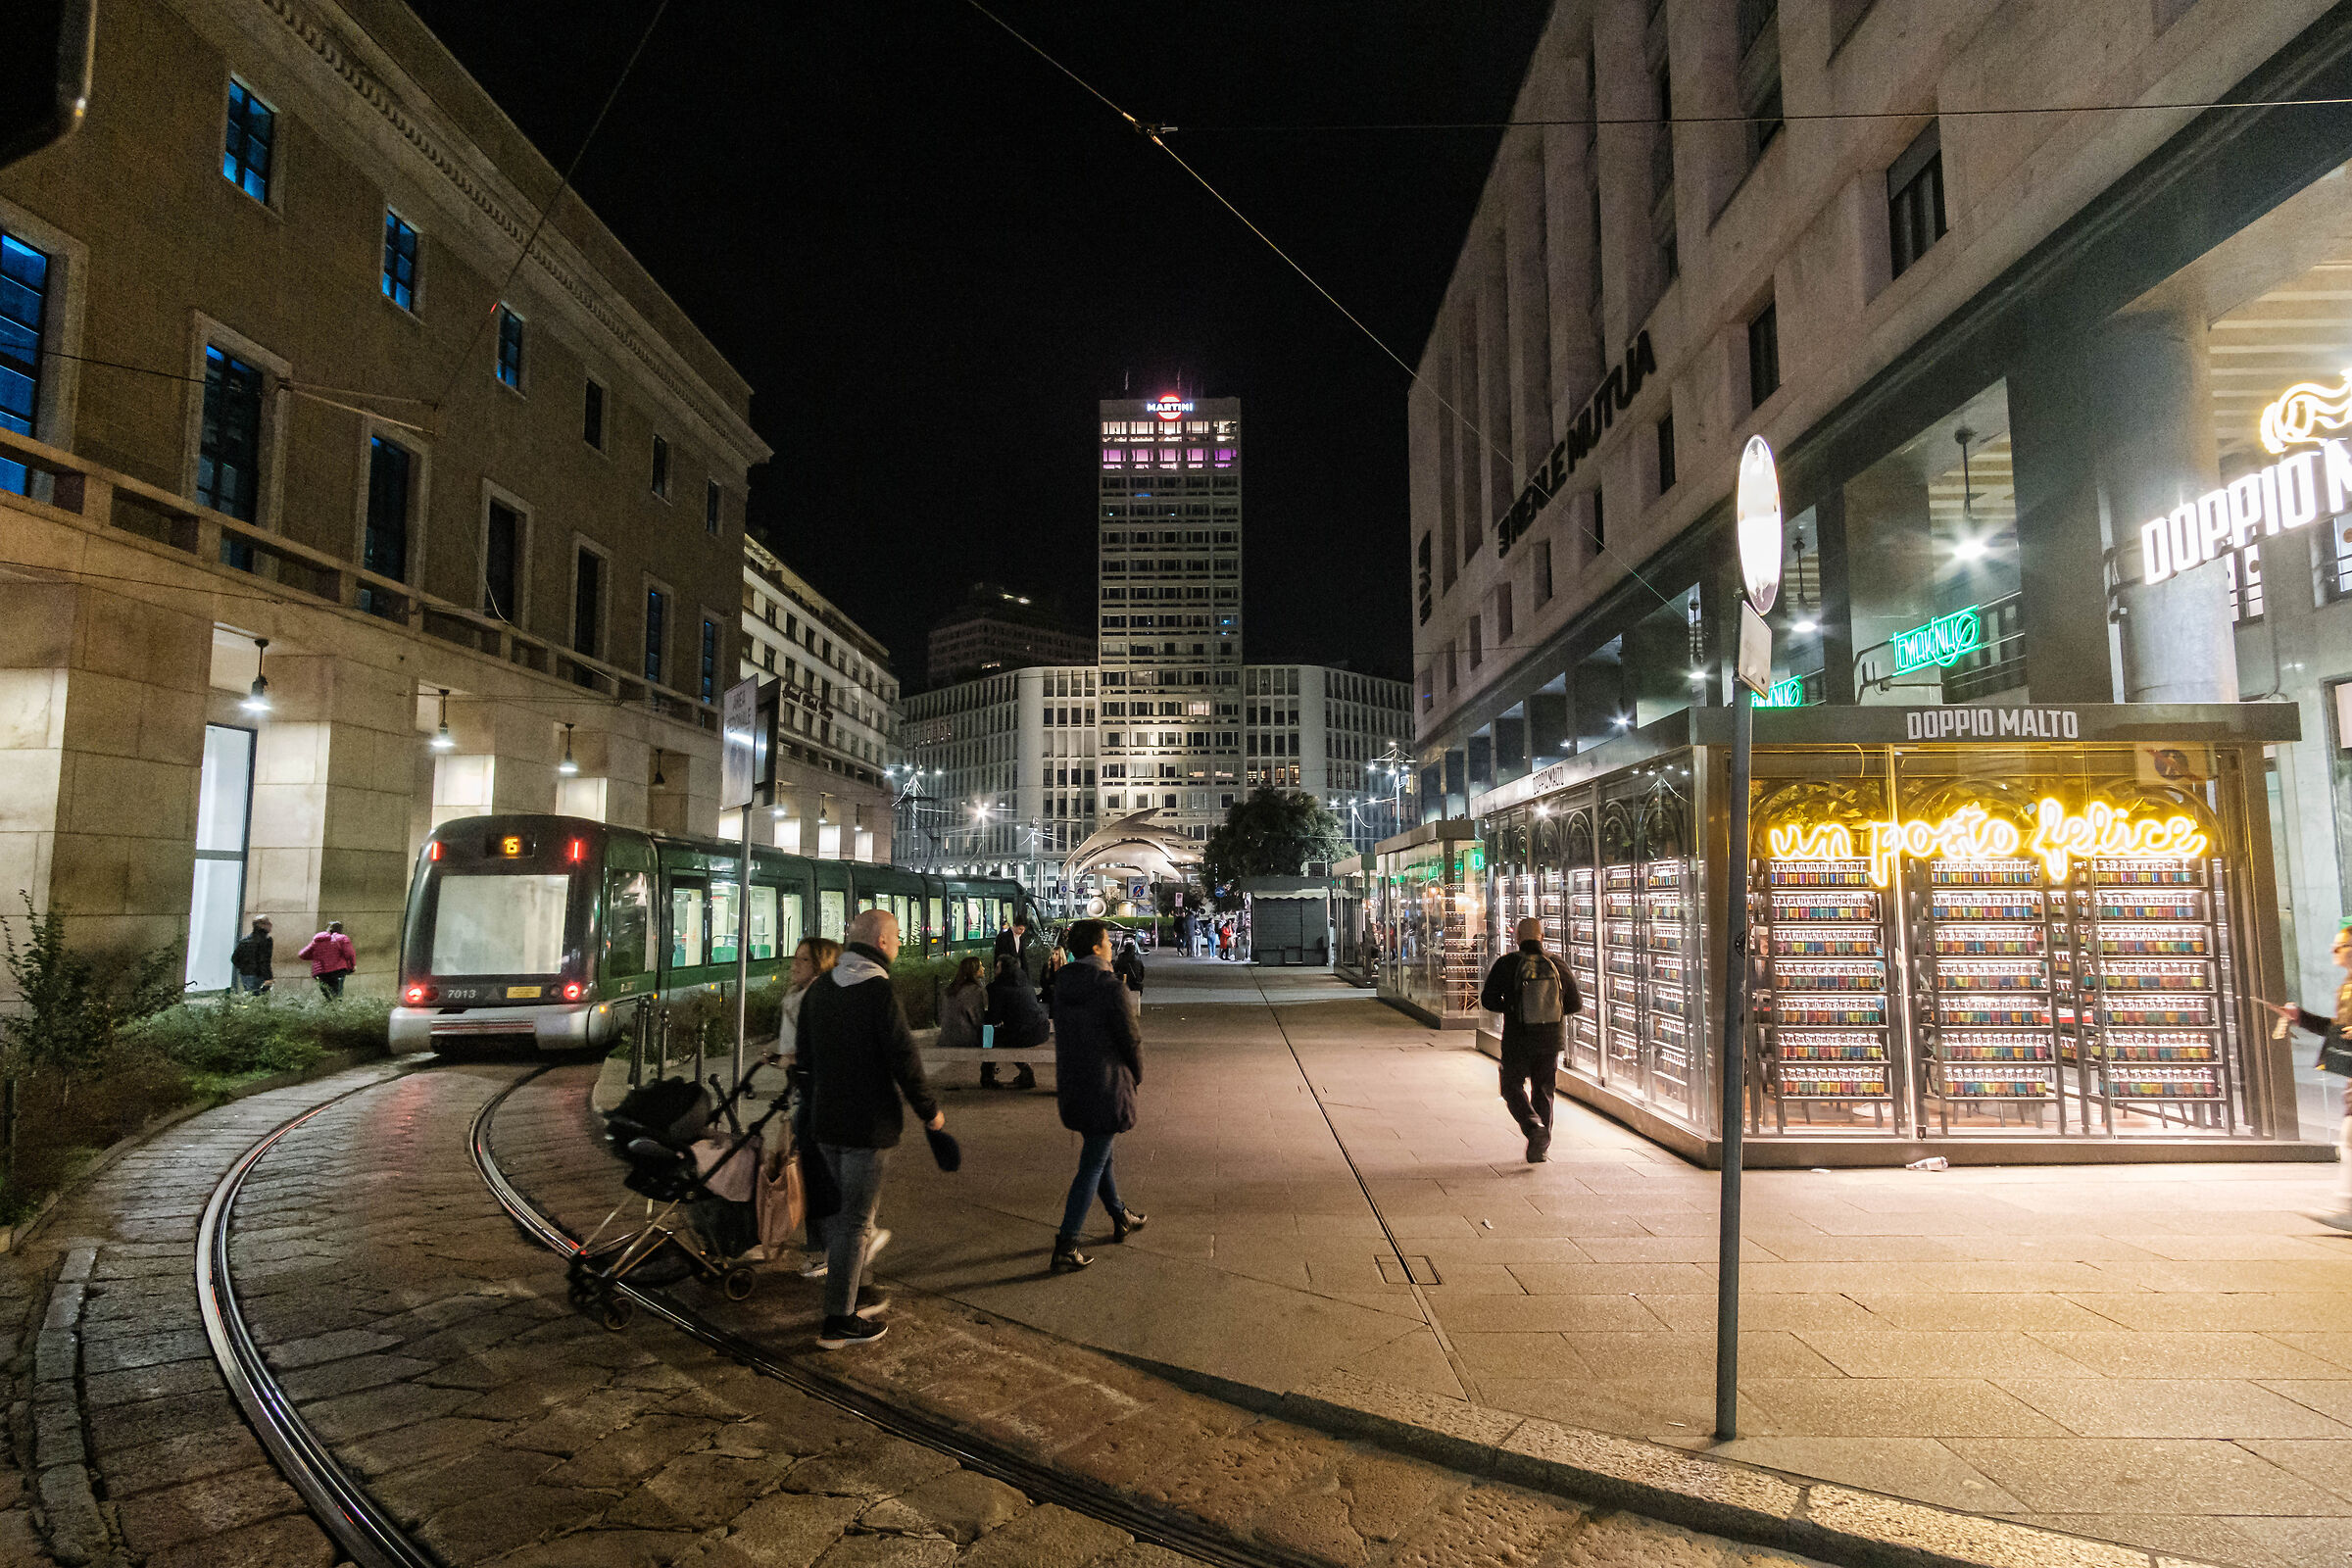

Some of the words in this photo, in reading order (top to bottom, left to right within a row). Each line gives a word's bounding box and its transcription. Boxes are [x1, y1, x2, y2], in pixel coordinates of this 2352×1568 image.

[1147, 403, 1194, 412] MARTINI
[2141, 451, 2319, 586] DOPPIO
[1906, 709, 1994, 740] DOPPIO
[1998, 709, 2079, 739] MALTO
[1769, 822, 1853, 861] un
[1870, 807, 2020, 887] posto
[2033, 797, 2208, 881] felice
[447, 989, 477, 1000] 7013
